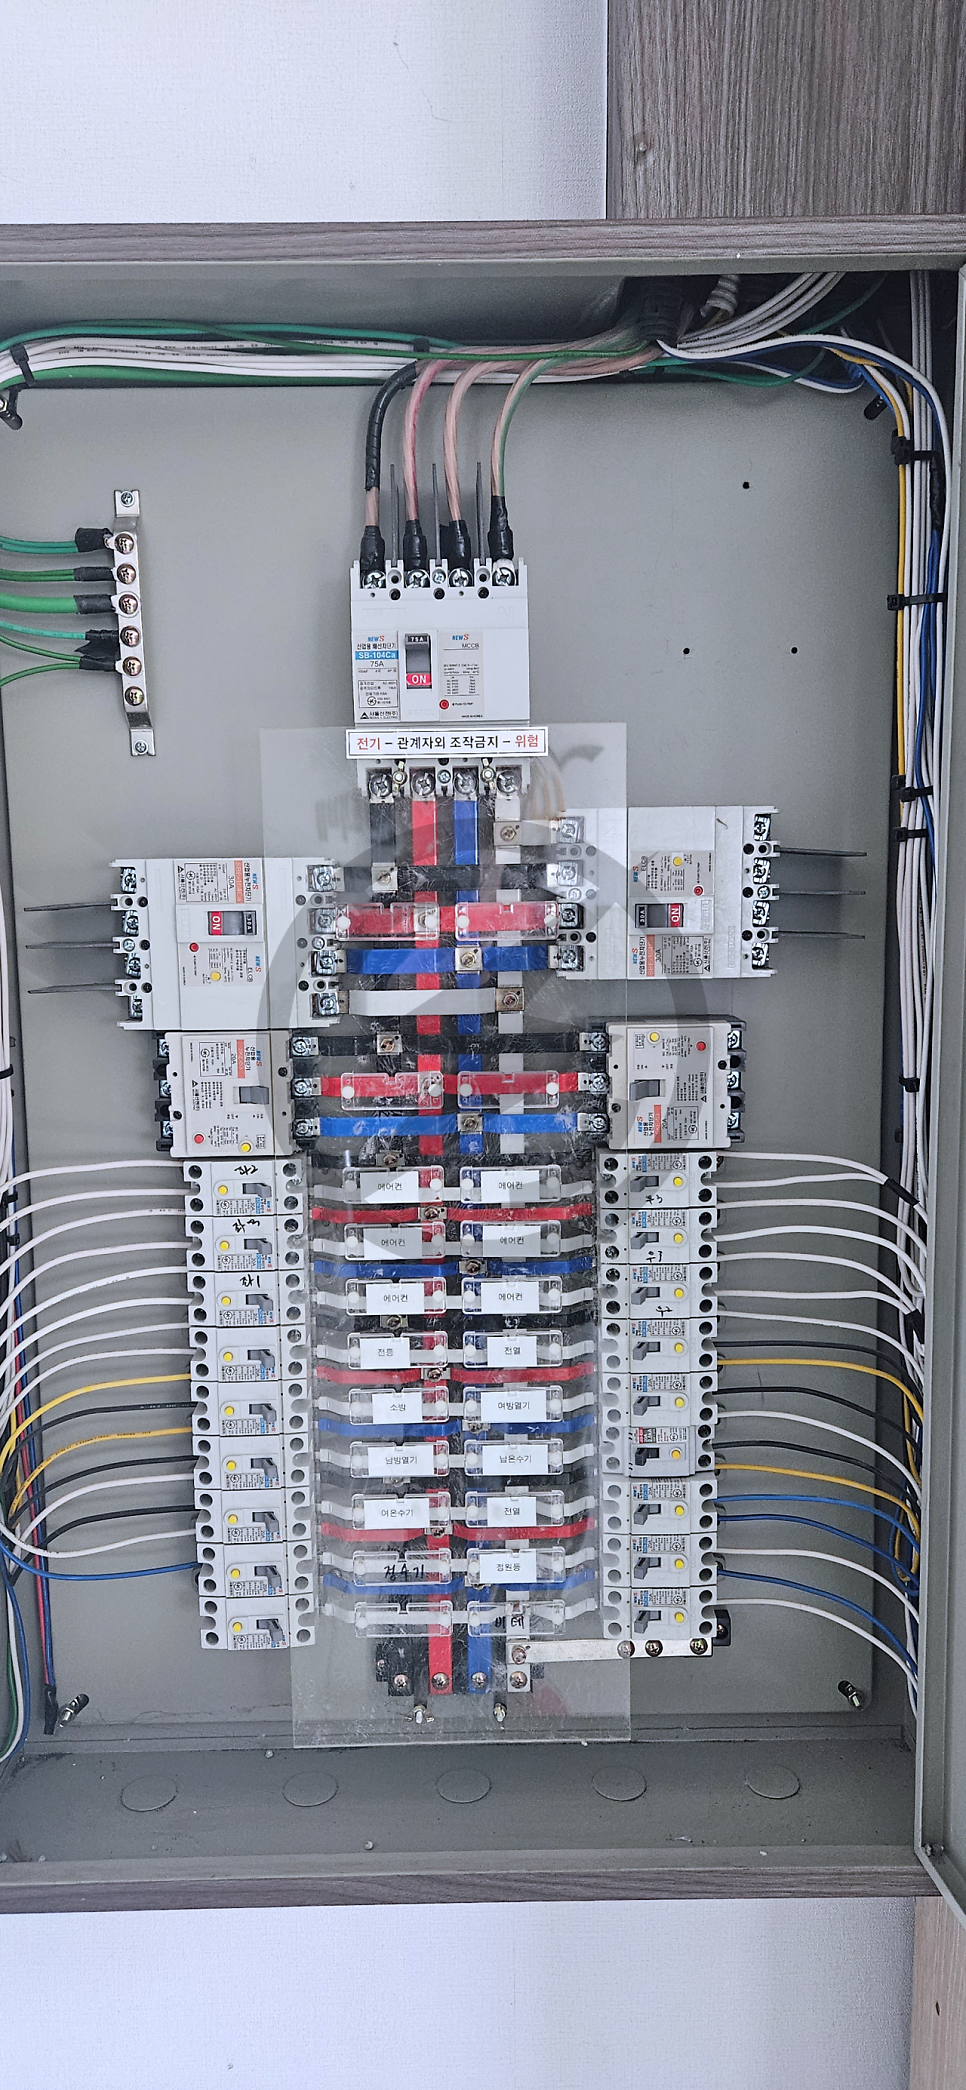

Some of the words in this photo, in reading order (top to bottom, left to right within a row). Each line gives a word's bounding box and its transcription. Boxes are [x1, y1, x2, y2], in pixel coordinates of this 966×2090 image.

[358, 651, 396, 659] SB-104Ca
[412, 675, 426, 683] ON
[357, 737, 381, 750] 전기
[397, 737, 446, 750] 관계자외
[450, 735, 498, 749] 조작금지
[515, 734, 539, 748] 위험
[671, 908, 679, 922] ON
[212, 916, 220, 930] ON
[378, 1182, 403, 1191] 에어컨
[498, 1180, 523, 1190] 에어컨
[381, 1237, 406, 1247] 에어컨
[500, 1236, 525, 1245] 에어컨
[383, 1293, 408, 1303] 에어컨
[498, 1292, 523, 1302] 에어컨
[378, 1348, 394, 1357] 전등
[505, 1347, 521, 1355] 전열
[498, 1402, 530, 1410] 여방열기
[381, 1509, 414, 1517] 여온수기
[504, 1507, 520, 1515] 전열
